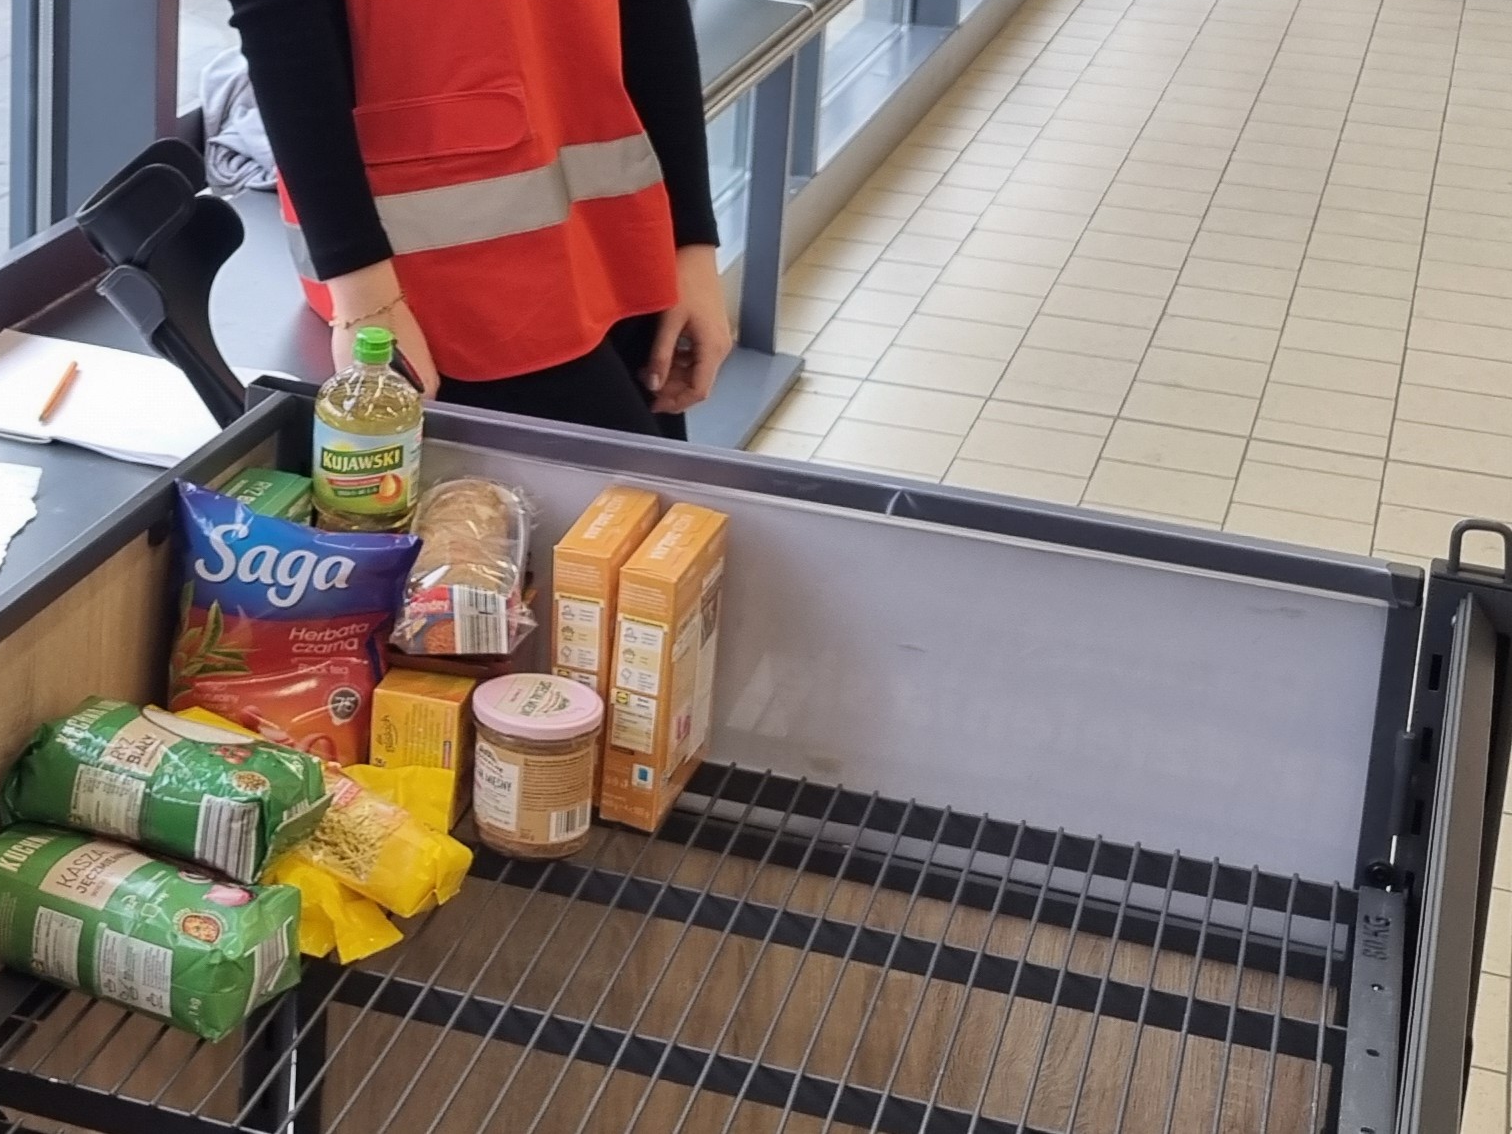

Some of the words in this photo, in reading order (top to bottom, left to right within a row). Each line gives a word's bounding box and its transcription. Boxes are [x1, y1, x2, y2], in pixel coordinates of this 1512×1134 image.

[323, 448, 401, 472] KUJAWSKI
[194, 523, 356, 608] Saga
[288, 623, 369, 641] Herbata
[291, 638, 359, 654] czarna
[56, 849, 111, 888] KASZA
